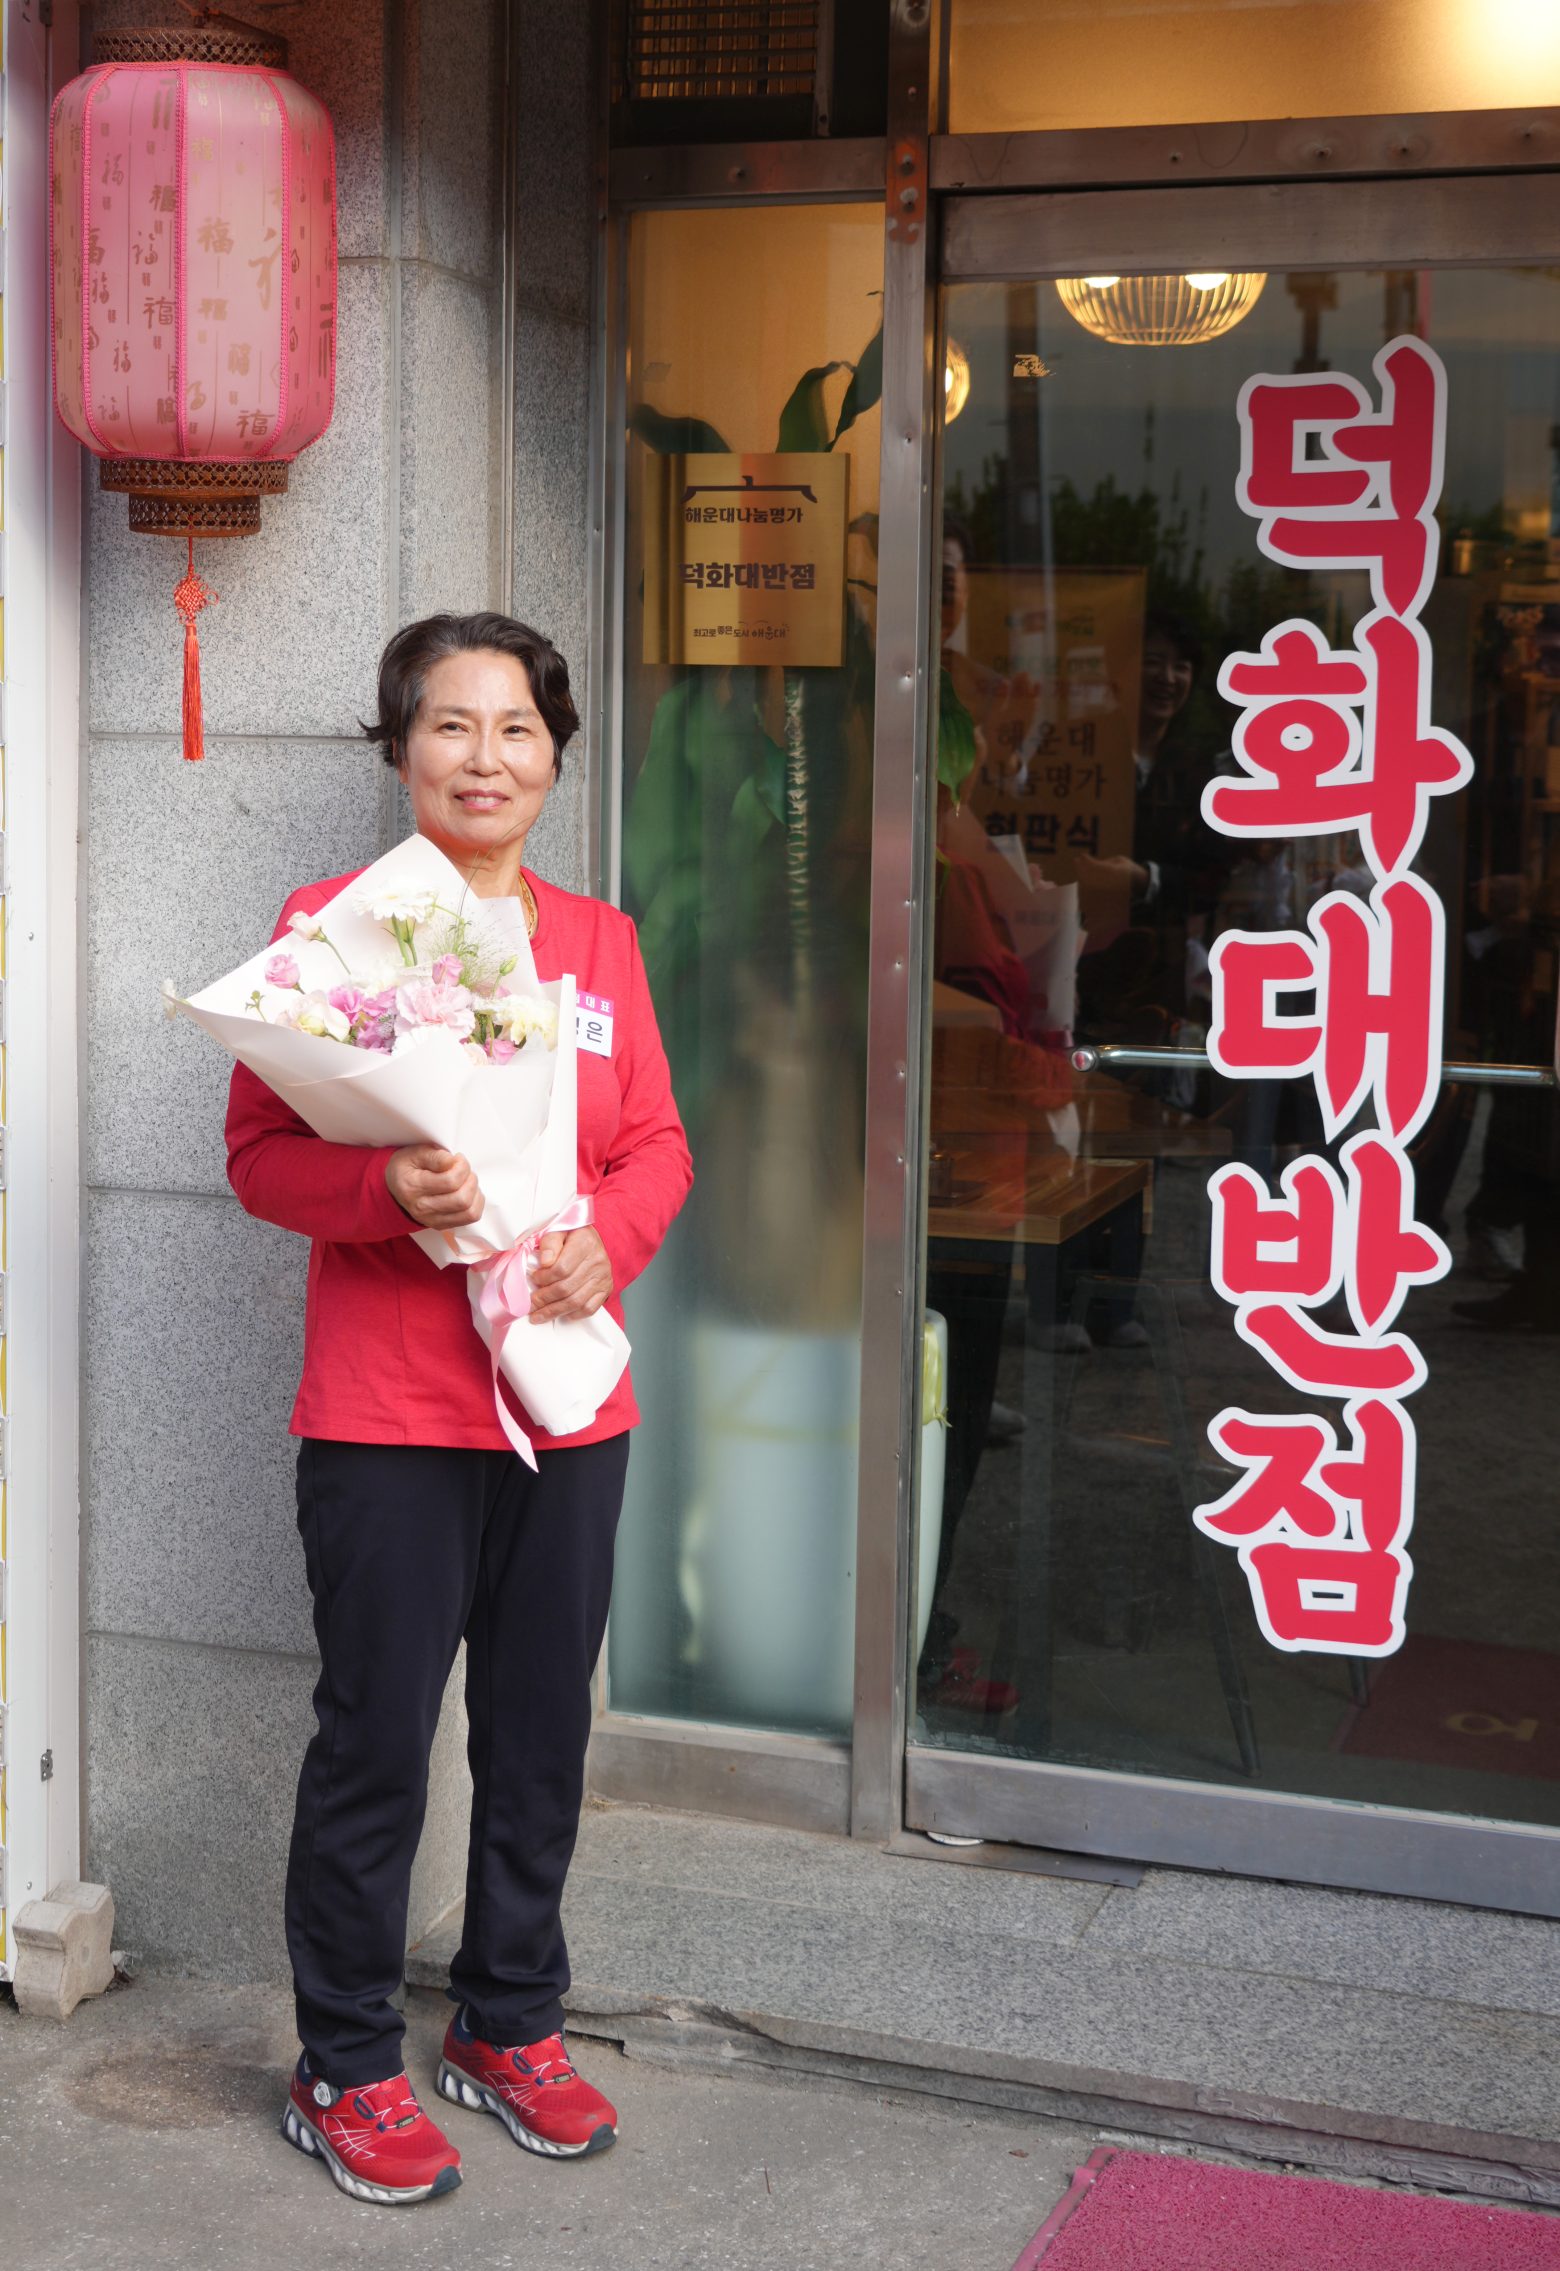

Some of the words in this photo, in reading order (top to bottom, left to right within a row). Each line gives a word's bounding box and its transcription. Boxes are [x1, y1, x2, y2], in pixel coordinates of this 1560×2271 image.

[197, 217, 235, 255] 福
[142, 296, 175, 330] 福
[236, 409, 276, 439] 福
[684, 507, 803, 524] 해운대나눔명가
[679, 562, 816, 590] 덕화대반점
[717, 625, 733, 635] 좋은
[733, 628, 750, 637] 도시
[1193, 334, 1475, 1658] 덕화대반점
[576, 1017, 603, 1044] 은
